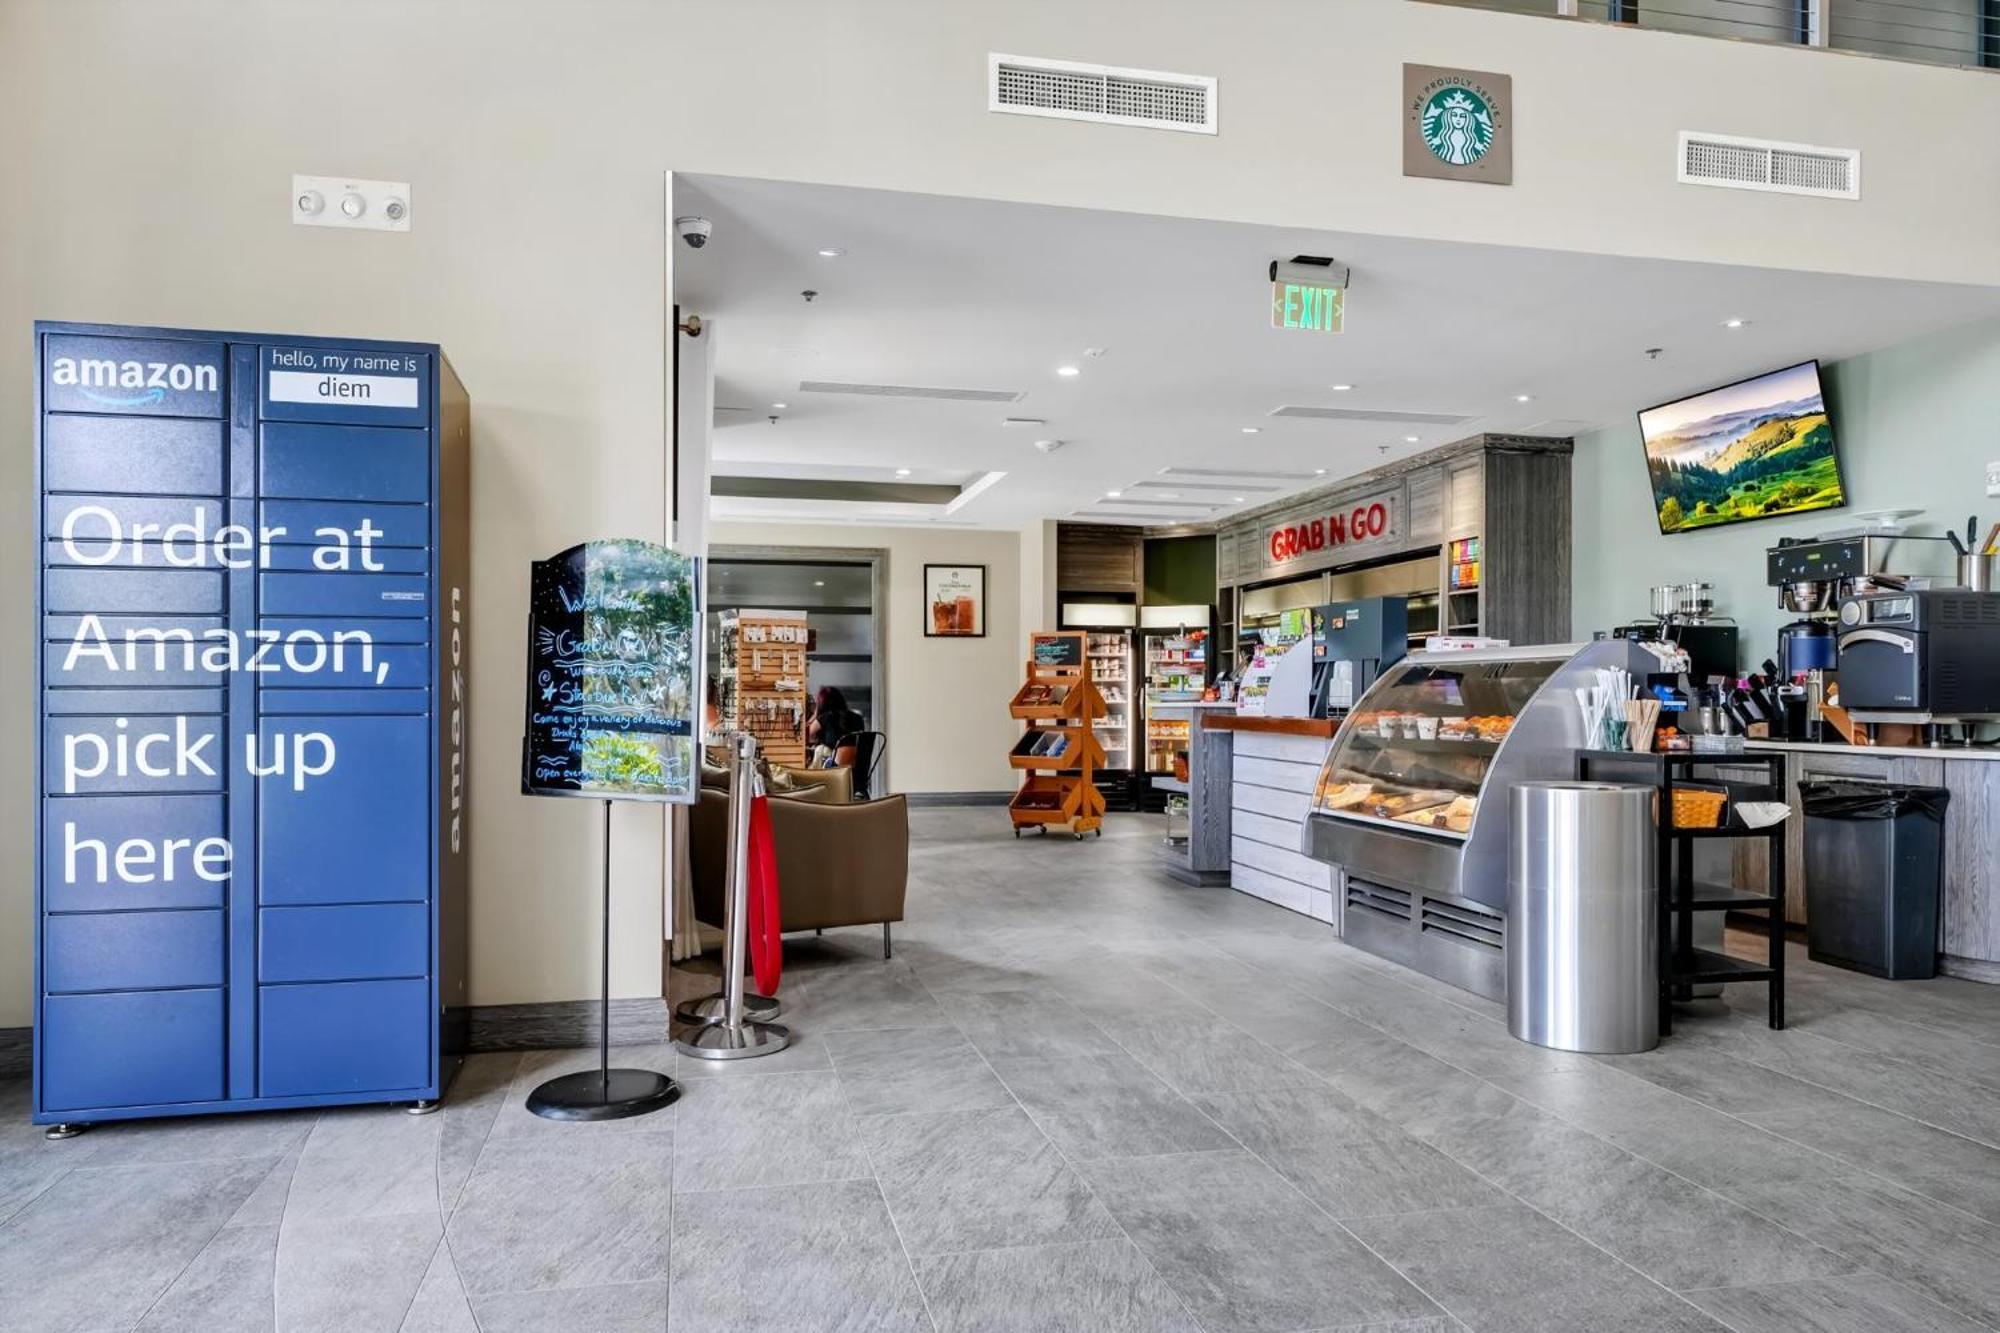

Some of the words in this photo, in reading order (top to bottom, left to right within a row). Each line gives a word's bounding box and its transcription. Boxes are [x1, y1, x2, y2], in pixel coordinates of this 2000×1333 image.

[1412, 93, 1425, 111] WE
[1424, 76, 1473, 93] PROUDLY
[1475, 85, 1501, 118] SERVE
[1284, 284, 1337, 332] EXIT
[51, 355, 218, 392] amazon
[271, 349, 318, 369] hello,
[323, 354, 349, 372] my
[353, 356, 400, 372] name
[404, 356, 417, 372] is
[317, 376, 371, 398] diem
[61, 505, 286, 570] Order
[312, 518, 385, 571] at
[1271, 518, 1325, 561] GRAB
[1329, 512, 1346, 546] N
[1351, 503, 1387, 540] GO
[62, 614, 390, 686] Amazon,
[533, 712, 559, 724] Come
[563, 713, 589, 730] enjoy
[64, 715, 217, 794] pick
[245, 732, 337, 791] up
[64, 822, 233, 883] here
